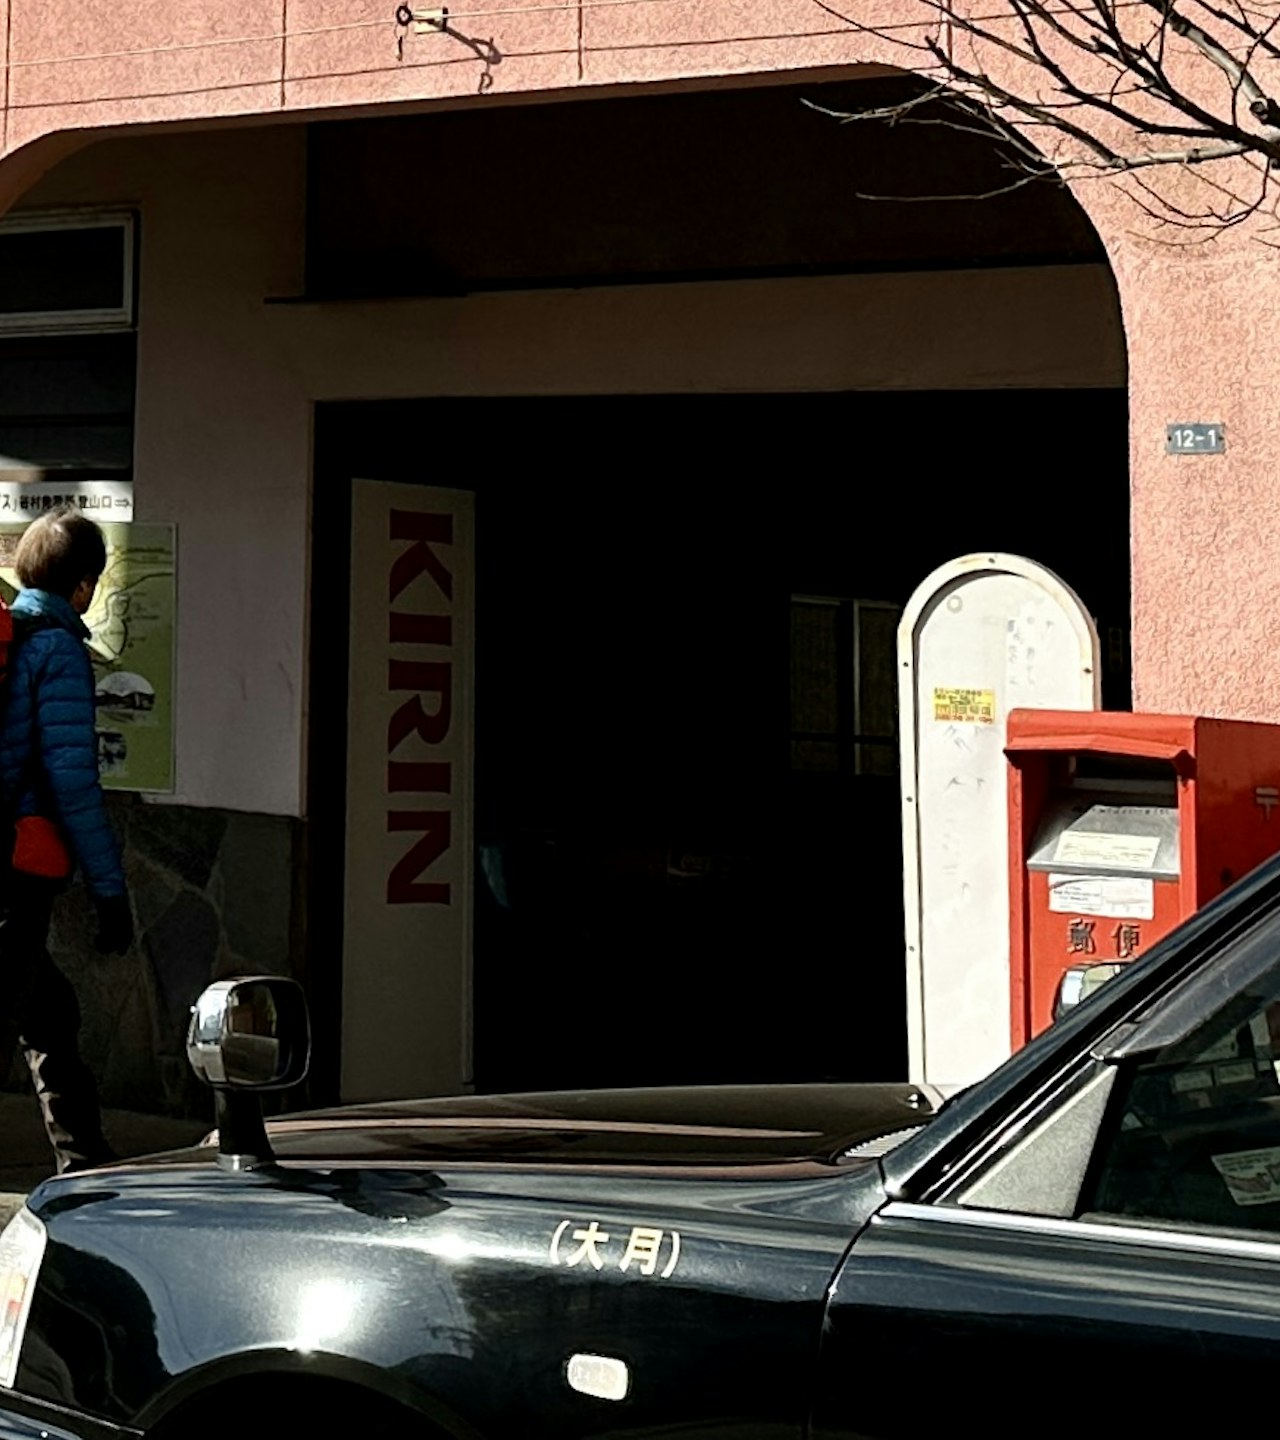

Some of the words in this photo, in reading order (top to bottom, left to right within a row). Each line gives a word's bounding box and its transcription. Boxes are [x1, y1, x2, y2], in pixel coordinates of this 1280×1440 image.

[1174, 429, 1216, 448] 12-1
[387, 508, 453, 905] KIRIN
[1066, 917, 1141, 958] 郵便
[549, 1220, 681, 1278] (大月)
